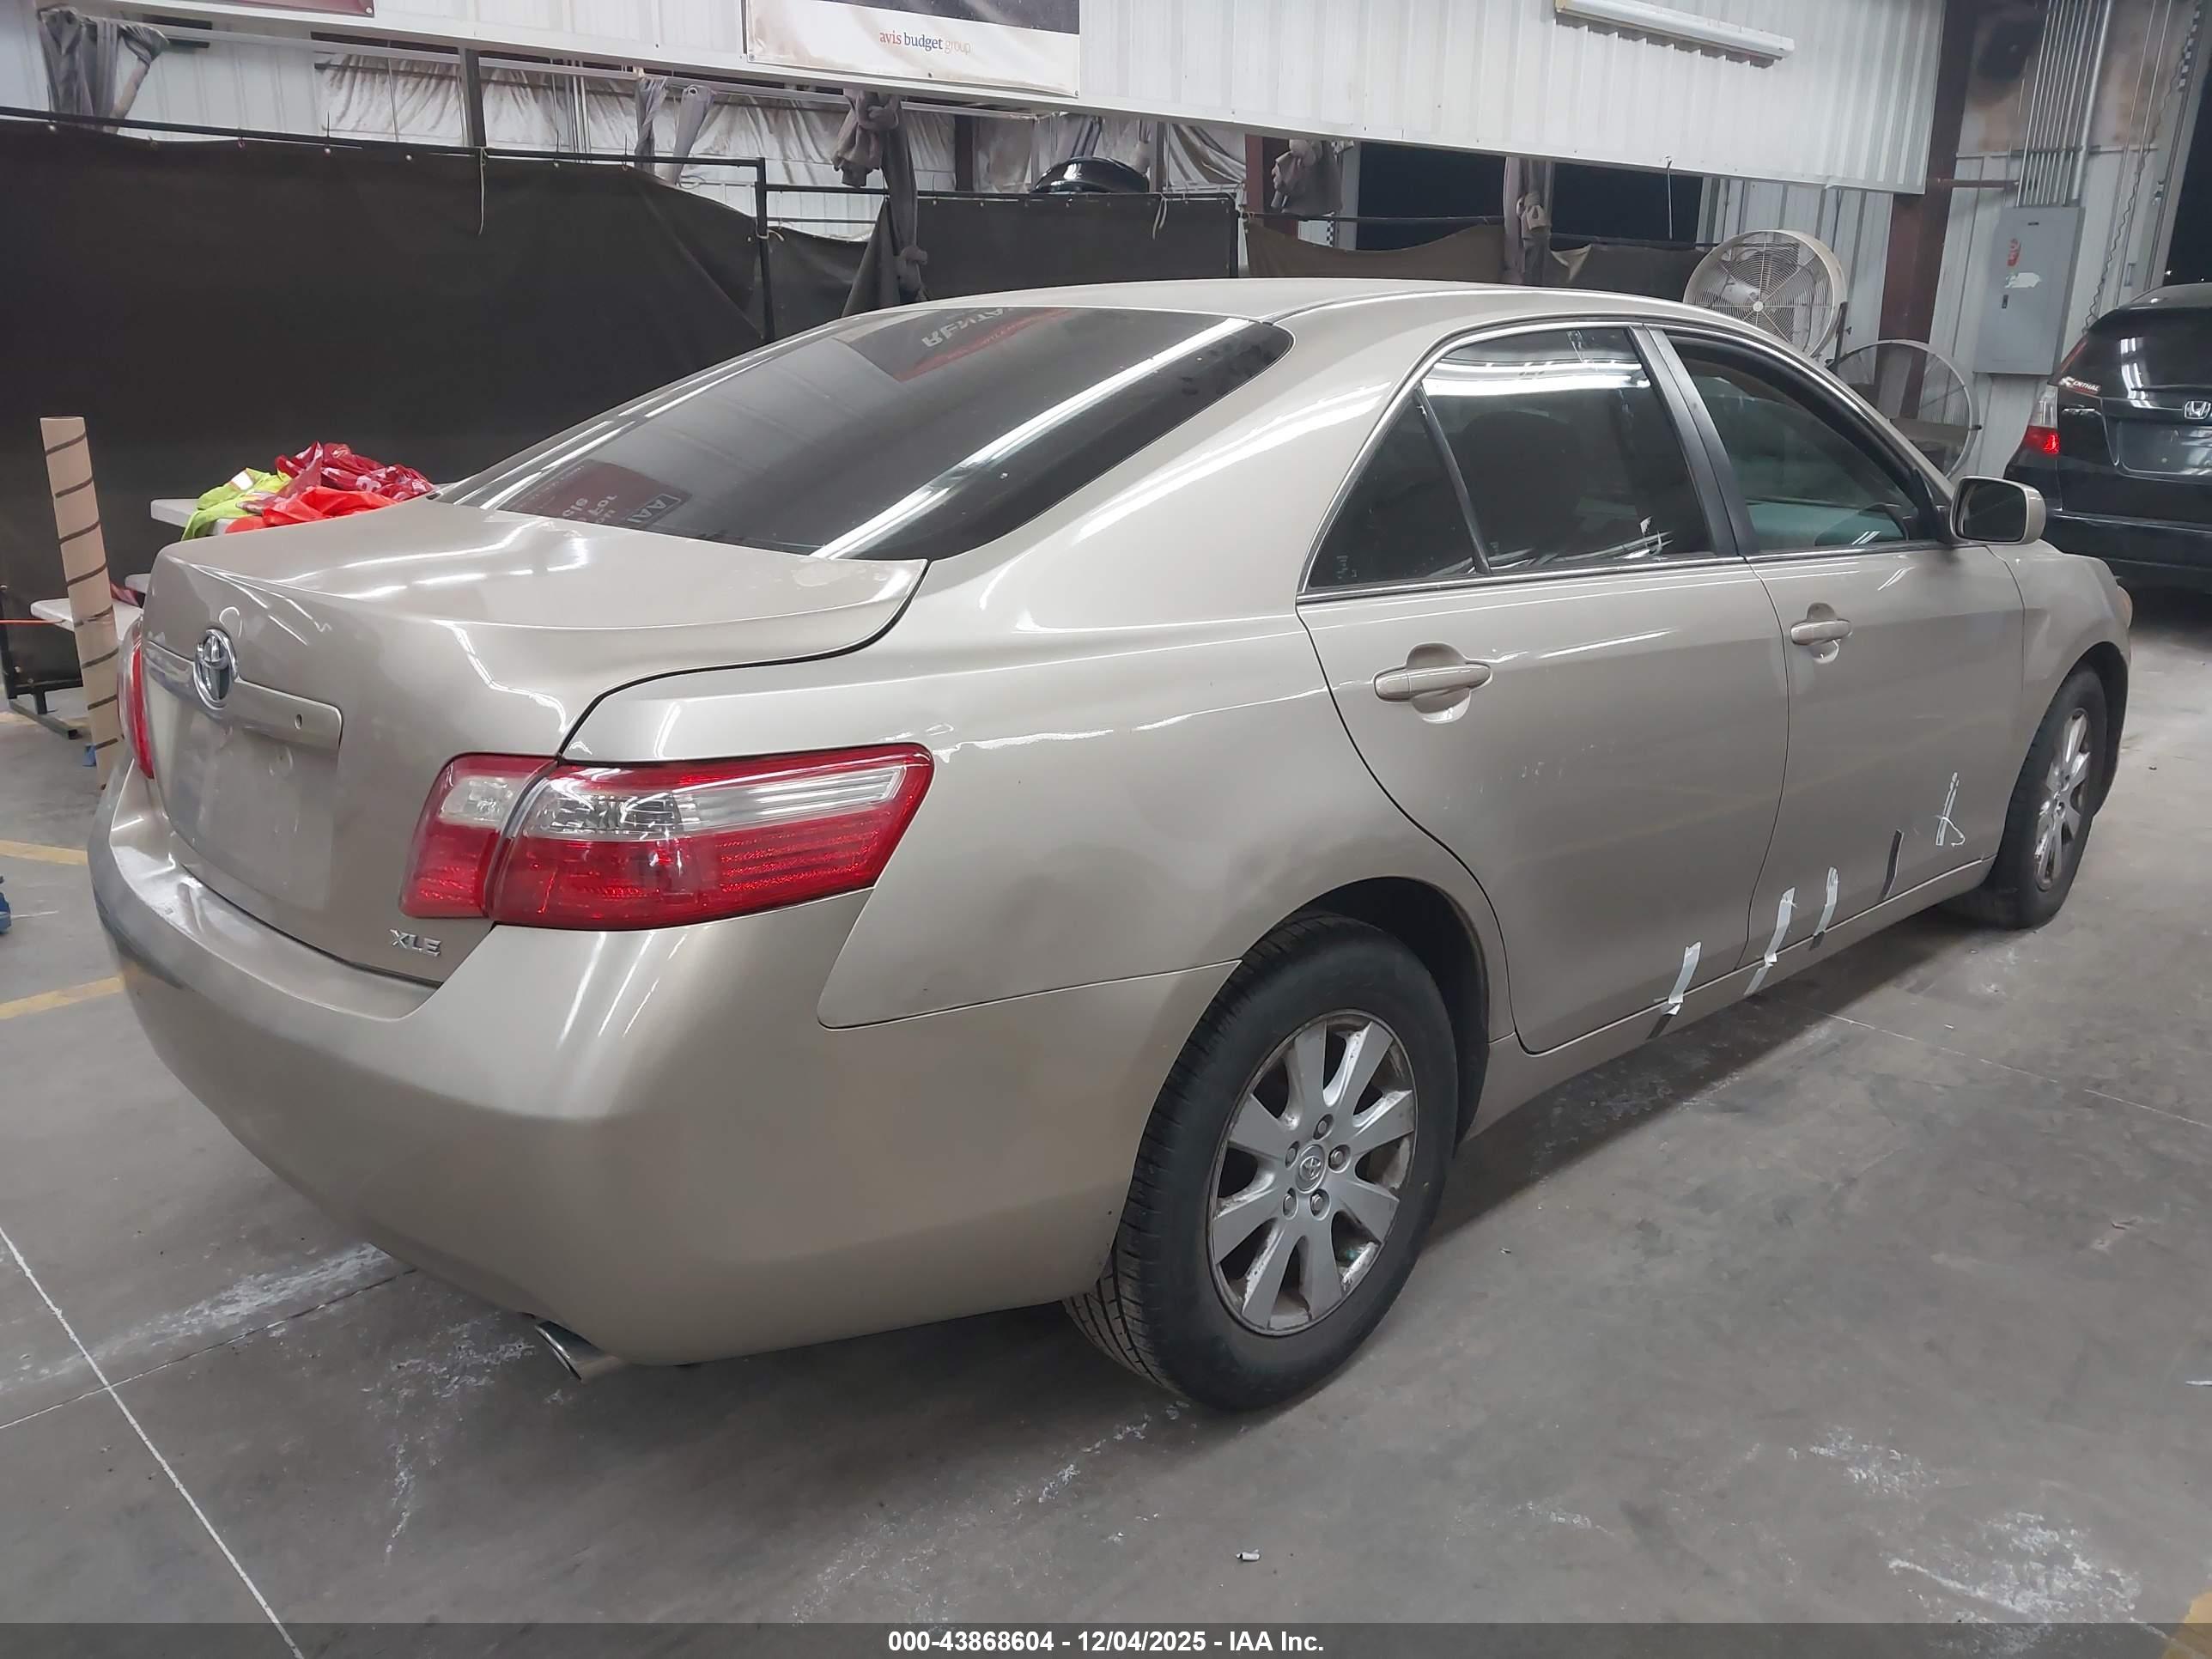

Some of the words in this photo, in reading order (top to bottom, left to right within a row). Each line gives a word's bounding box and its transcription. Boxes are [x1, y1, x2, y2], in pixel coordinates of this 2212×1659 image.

[879, 30, 902, 45] avis
[903, 32, 943, 52] budget
[944, 40, 971, 55] group
[389, 928, 442, 957] XLE
